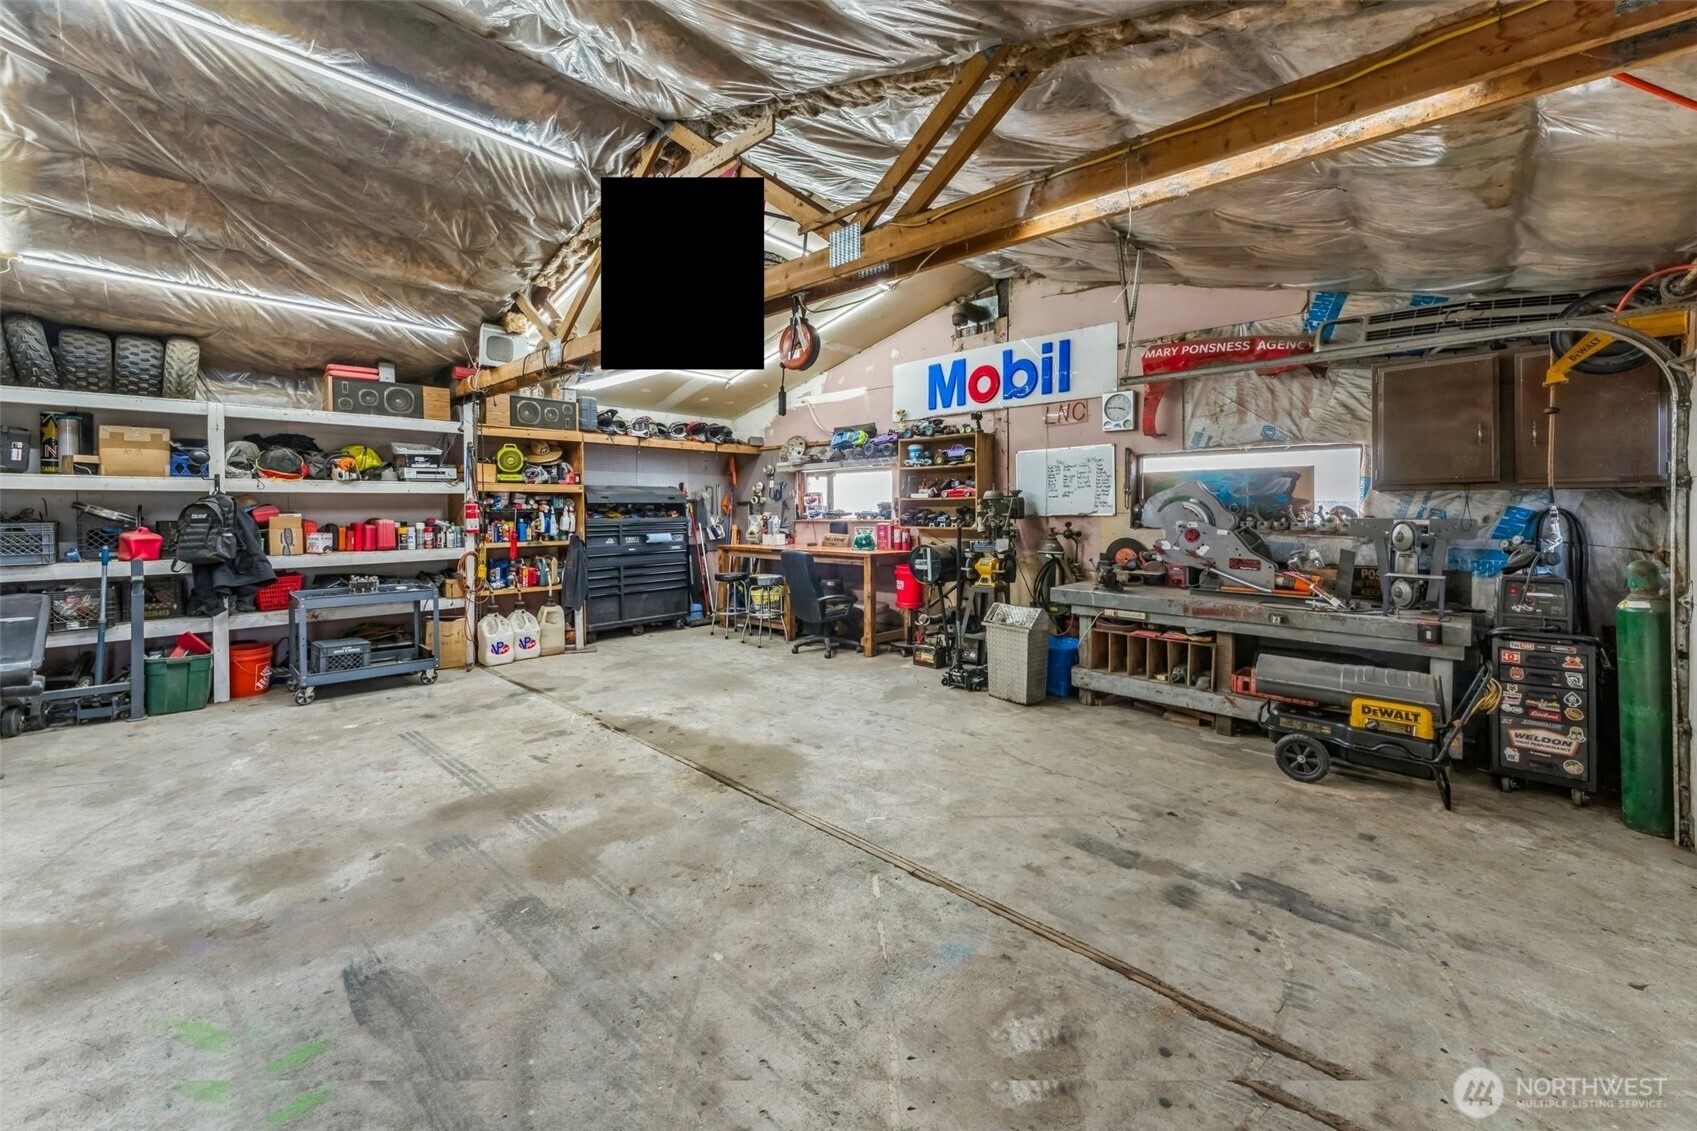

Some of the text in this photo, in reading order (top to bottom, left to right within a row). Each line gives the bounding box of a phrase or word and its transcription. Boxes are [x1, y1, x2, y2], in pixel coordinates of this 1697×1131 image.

[1145, 347, 1179, 359] MARY
[1181, 340, 1251, 355] PONSNESS
[928, 339, 1071, 410] Mobil
[1362, 704, 1421, 723] DEWALT
[1514, 732, 1573, 748] WELDON
